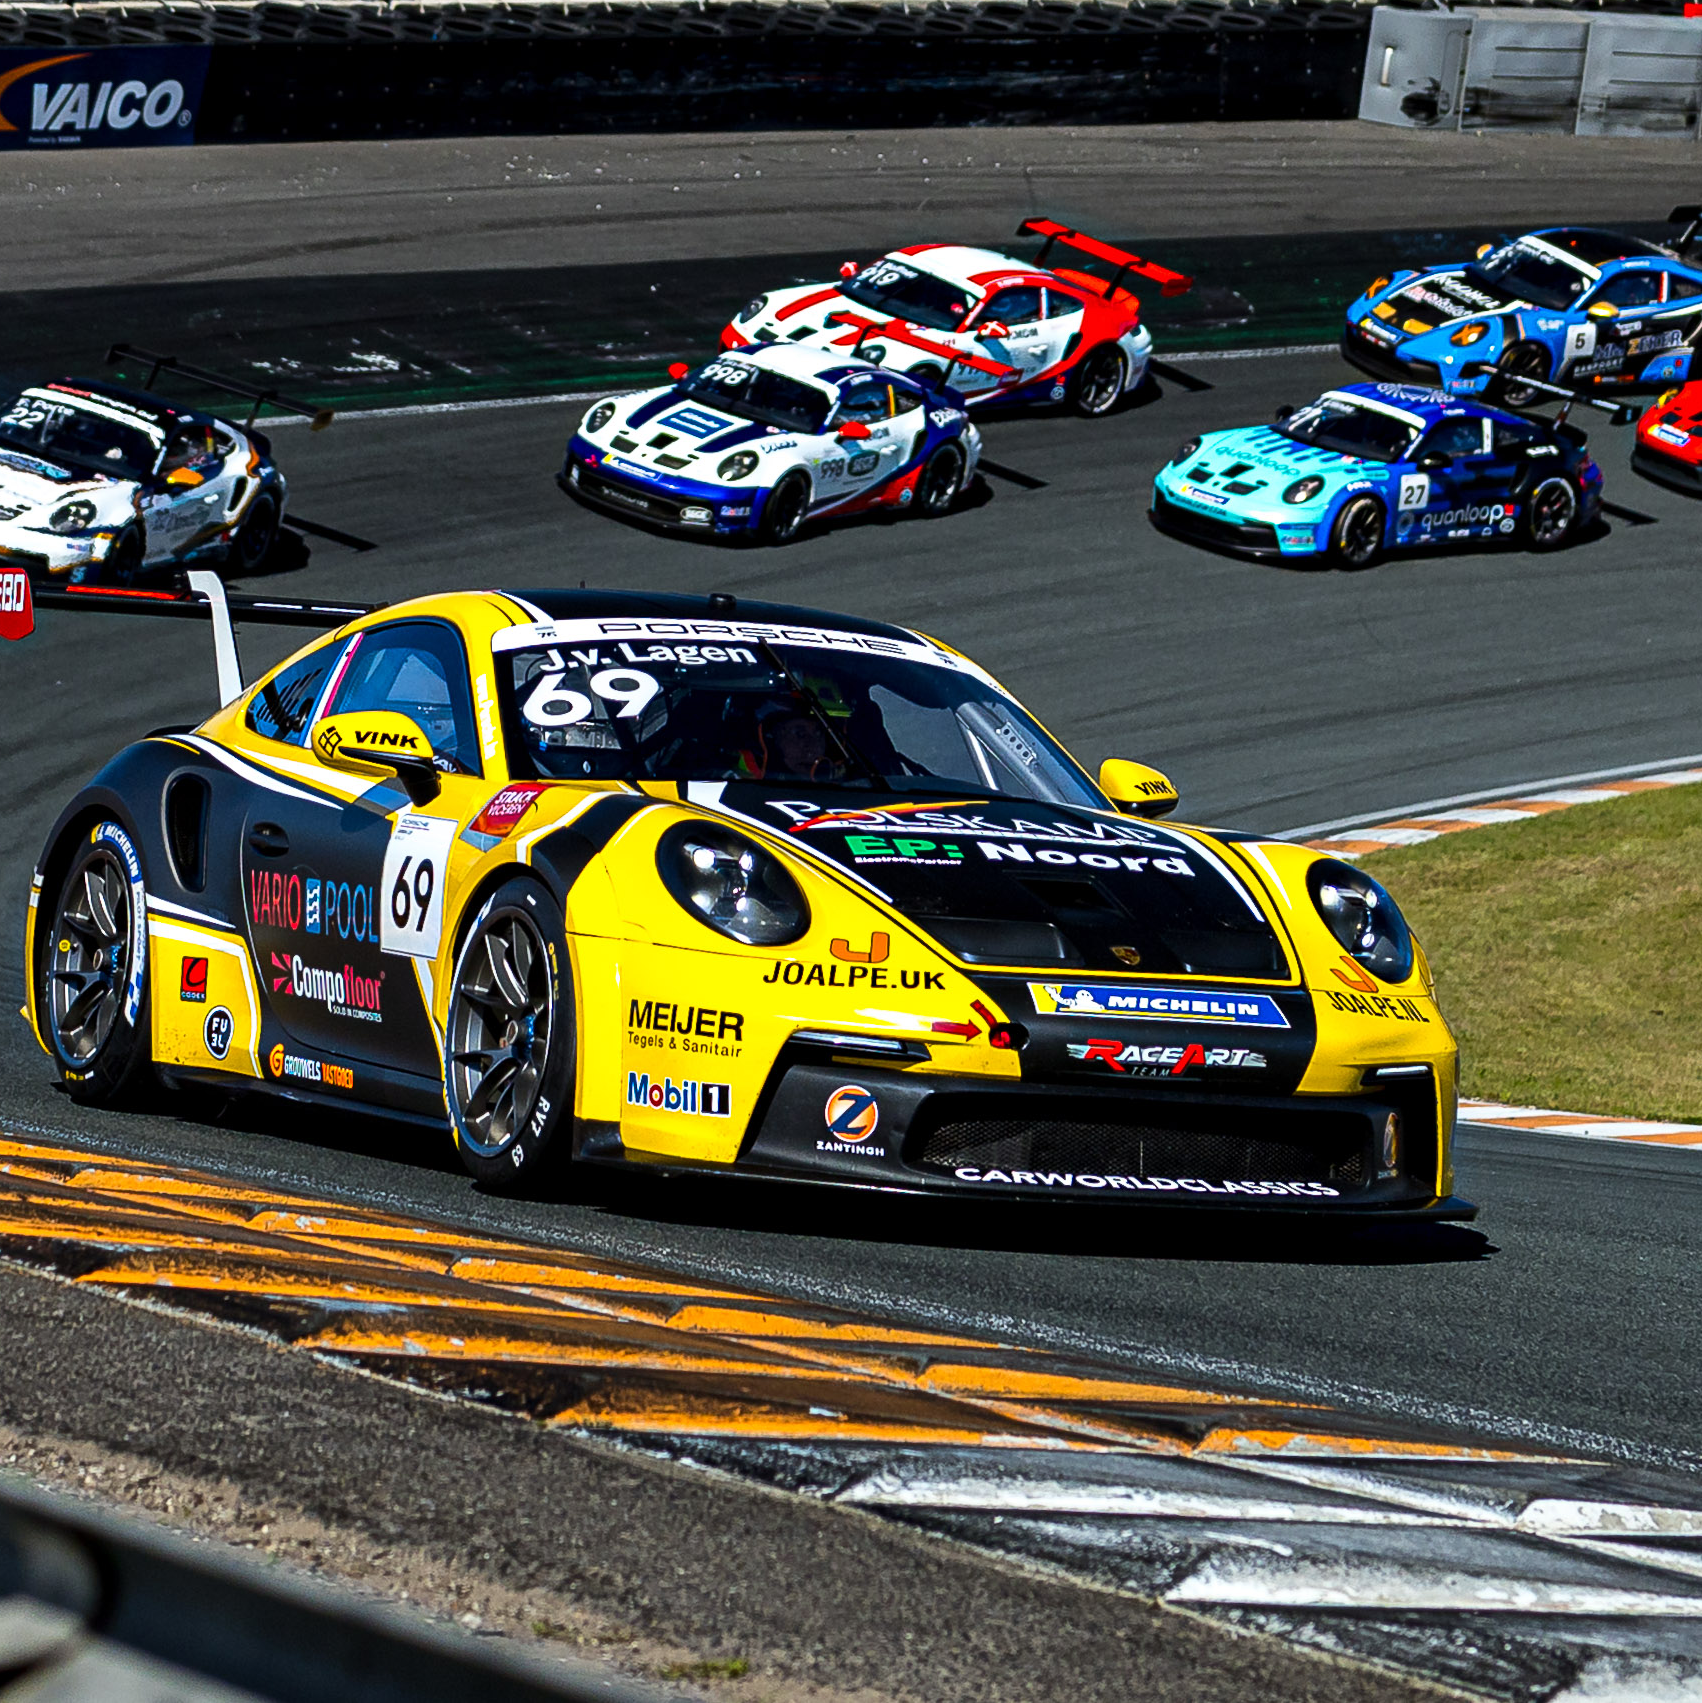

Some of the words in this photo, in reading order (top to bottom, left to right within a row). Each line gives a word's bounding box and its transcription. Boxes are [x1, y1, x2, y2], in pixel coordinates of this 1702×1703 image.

[31, 79, 185, 131] VAICO
[1575, 333, 1586, 350] 5
[699, 363, 749, 386] 998
[0, 407, 46, 430] 22
[820, 458, 846, 479] 998
[1403, 484, 1426, 505] 27
[1421, 504, 1504, 532] quanloop
[598, 623, 905, 655] PORSCHE
[624, 642, 758, 668] Lagen
[522, 668, 660, 726] 69
[354, 730, 420, 749] VINK
[1134, 780, 1173, 796] VINK
[765, 800, 1158, 844] POLSKAMP
[104, 824, 139, 879] MICHELIN
[844, 835, 965, 859] EP:
[975, 841, 1196, 878] Noord
[250, 869, 301, 931] VARIO
[325, 880, 379, 943] POOL
[391, 855, 435, 933] 69
[292, 954, 381, 1012] Compofloor
[762, 960, 947, 991] JOALPE.UK
[629, 999, 745, 1042] MEIJER
[1108, 995, 1260, 1017] MICHELIN
[1327, 991, 1430, 1025] JOALPE.NL
[212, 1017, 228, 1032] FU
[628, 1031, 664, 1050] Tegels
[669, 1037, 678, 1050] &
[682, 1038, 742, 1058] Sanitair
[1131, 1066, 1170, 1077] TEAM
[627, 1072, 698, 1114] Mobil
[816, 1141, 885, 1156] ZANTINGH
[954, 1166, 1340, 1197] CARWORLDCLASSICS
